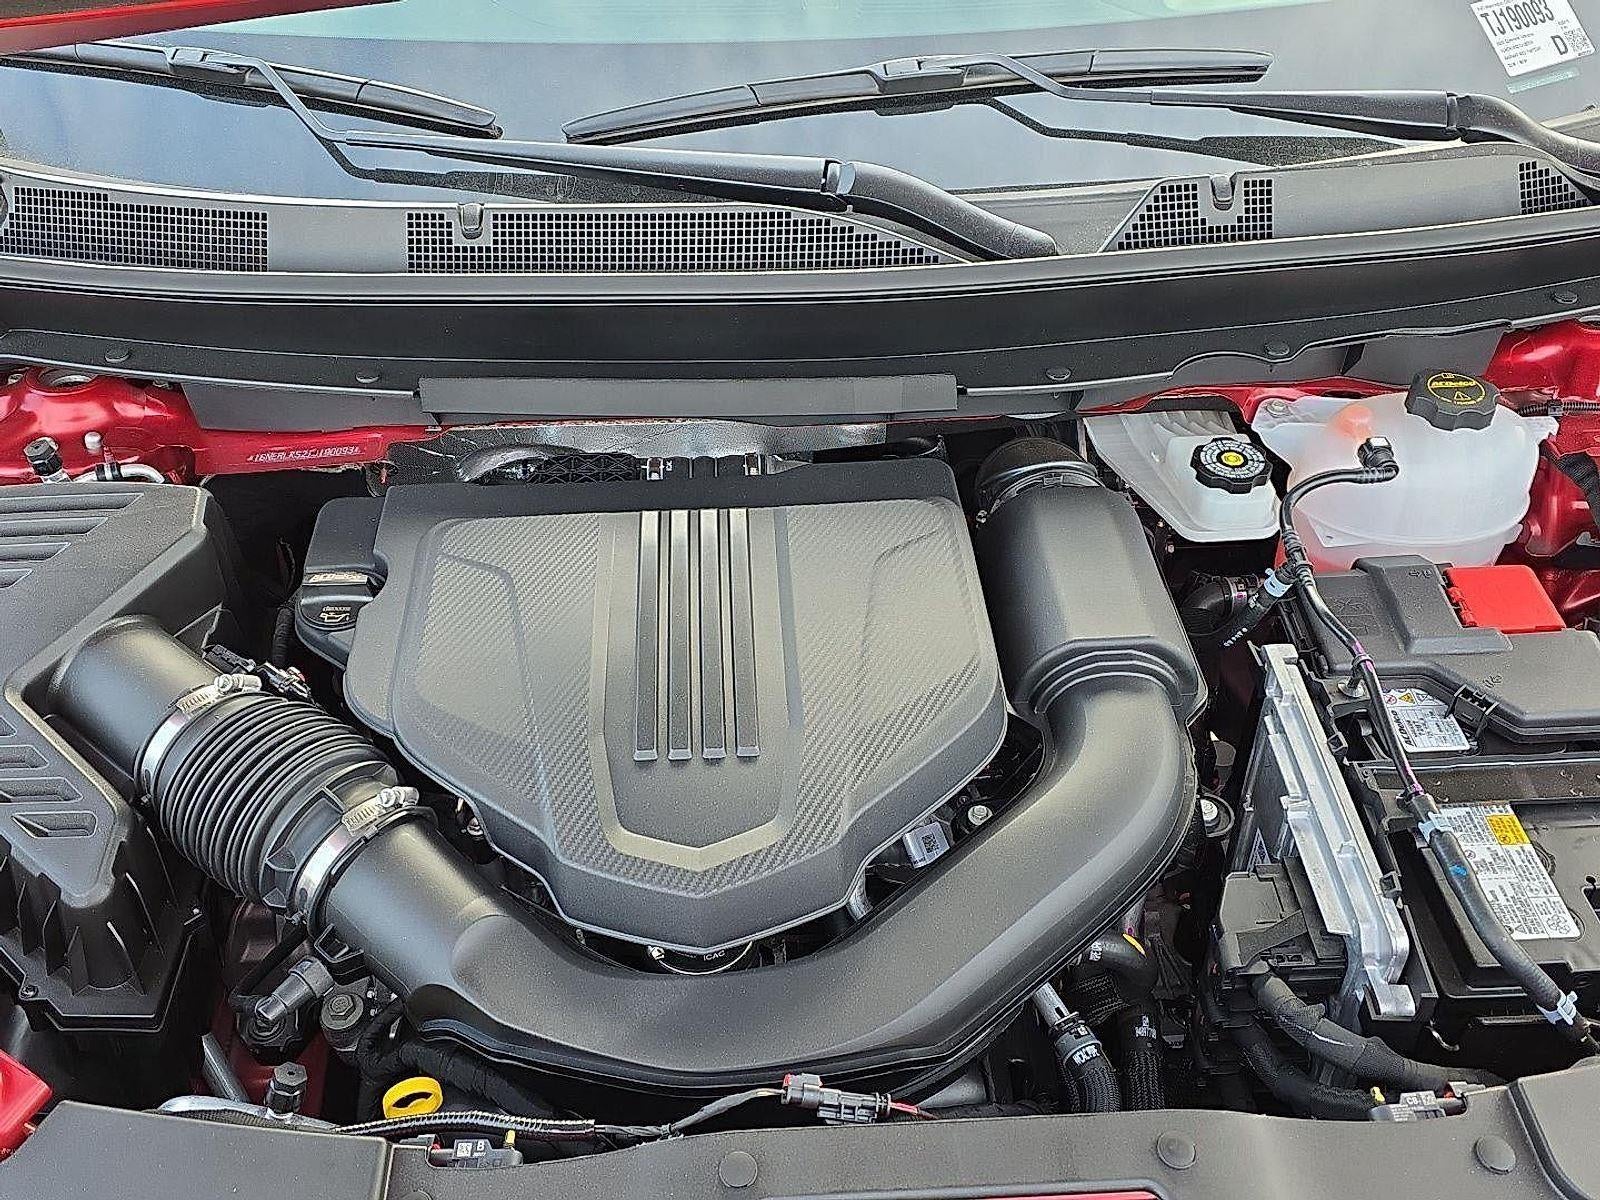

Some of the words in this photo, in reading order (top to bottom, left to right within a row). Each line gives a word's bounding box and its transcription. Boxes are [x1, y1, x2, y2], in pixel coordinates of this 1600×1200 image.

[1480, 0, 1554, 36] TJ190093
[1551, 35, 1568, 55] D
[703, 949, 726, 961] ICAC
